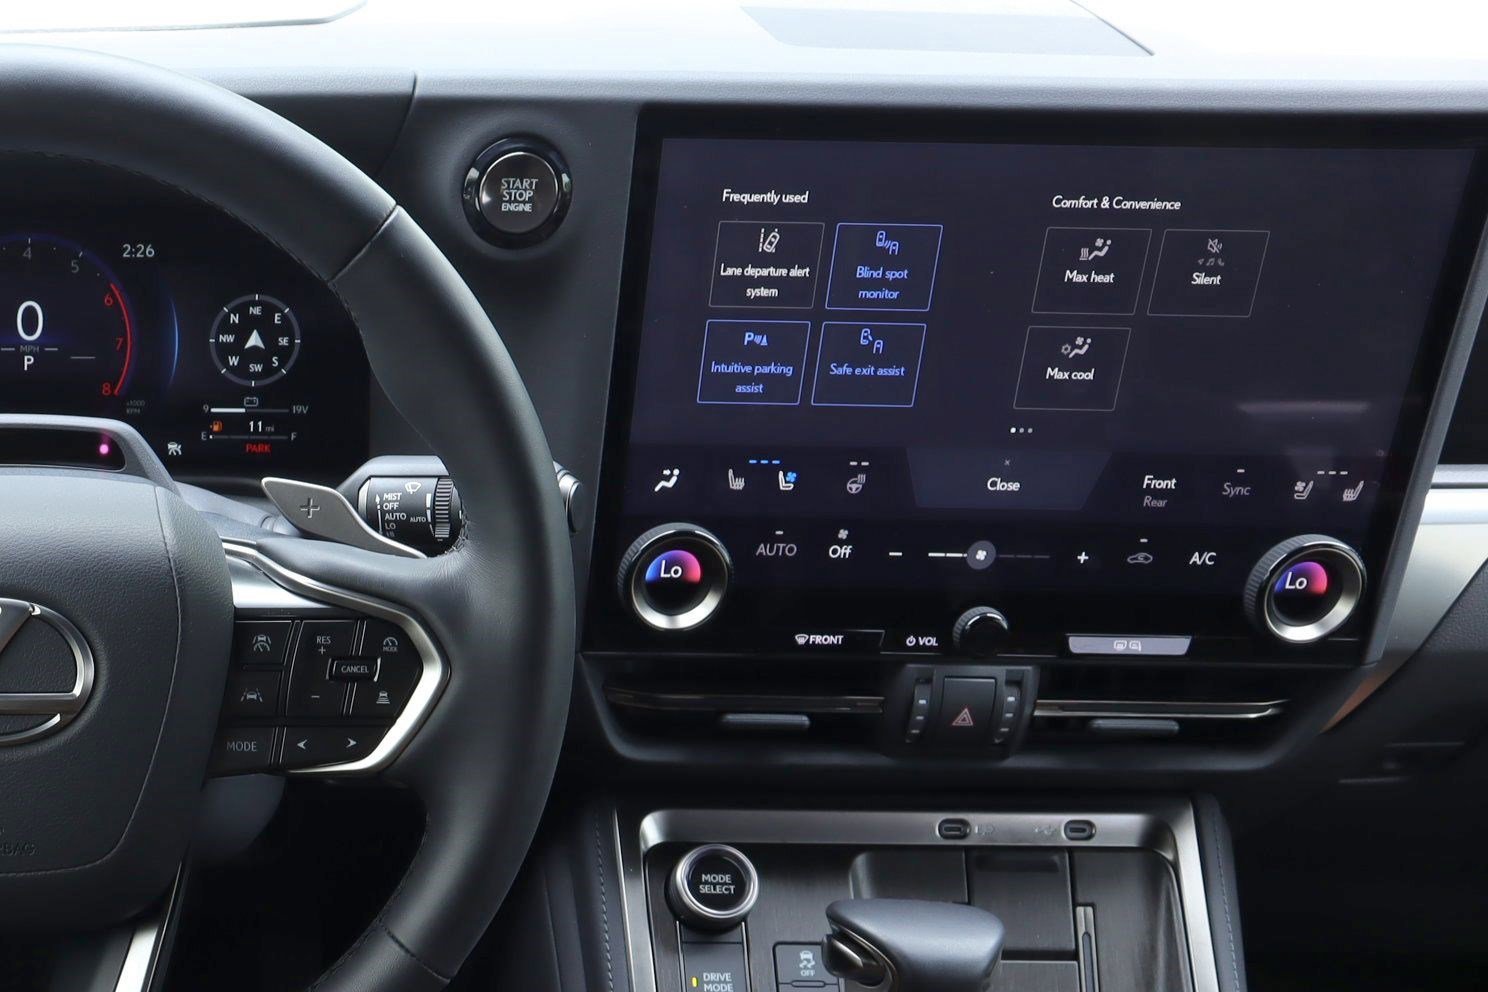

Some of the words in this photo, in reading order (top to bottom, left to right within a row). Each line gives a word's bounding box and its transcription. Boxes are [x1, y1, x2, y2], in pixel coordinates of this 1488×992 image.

[500, 177, 539, 190] START
[502, 189, 534, 202] STOP
[722, 188, 781, 206] Frequently
[781, 190, 809, 204] used
[1052, 194, 1099, 209] Comfort
[1100, 195, 1111, 209] &
[1112, 196, 1182, 210] Convenience
[501, 202, 533, 213] ENGINE
[22, 246, 32, 260] 4
[122, 243, 155, 258] 2:26
[70, 259, 80, 274] 5
[720, 262, 743, 276] Lane
[743, 263, 788, 279] departure
[788, 264, 811, 278] alert
[856, 265, 883, 279] Blind
[884, 269, 909, 281] spot
[1064, 269, 1089, 283] Max
[1090, 270, 1115, 283] heat
[1191, 271, 1222, 285] Silent
[745, 286, 779, 300] system
[858, 287, 900, 300] monitor
[103, 293, 114, 307] 6
[249, 305, 262, 316] NE
[16, 300, 44, 342] 0
[229, 313, 239, 324] N
[218, 334, 235, 343] NW
[278, 336, 289, 346] SE
[19, 342, 40, 353] MPH
[23, 355, 35, 371] P
[228, 355, 240, 367] W
[249, 363, 264, 373] SW
[710, 360, 753, 374] Intuitive
[753, 361, 794, 377] parking
[829, 362, 853, 375] Safe
[854, 364, 876, 376] exit
[876, 365, 906, 377] assist
[1045, 366, 1071, 380] Max
[1071, 367, 1095, 381] cool
[101, 382, 112, 396] 8
[735, 382, 764, 394] assist
[292, 404, 309, 414] 19V
[249, 420, 262, 433] 11
[245, 443, 271, 453] PARK
[986, 477, 1021, 492] Close
[1142, 474, 1177, 490] Front
[382, 491, 403, 501] MIST
[1222, 481, 1252, 498] Sync
[382, 501, 400, 511] OFF
[1142, 495, 1168, 508] Rear
[384, 512, 407, 521] AUTO
[755, 543, 798, 557] AUTO
[828, 544, 853, 559] Off
[1188, 551, 1217, 566] A/C
[659, 559, 683, 579] Lo
[1284, 570, 1308, 590] Lo
[316, 635, 332, 645] RES
[807, 634, 844, 645] FRONT
[918, 636, 939, 647] VOL
[340, 665, 369, 674] CANCEL
[227, 741, 257, 752] MODE
[701, 873, 732, 884] MODE
[699, 884, 736, 895] SELECT
[702, 972, 732, 982] DRIVE
[703, 983, 734, 992] MODE
